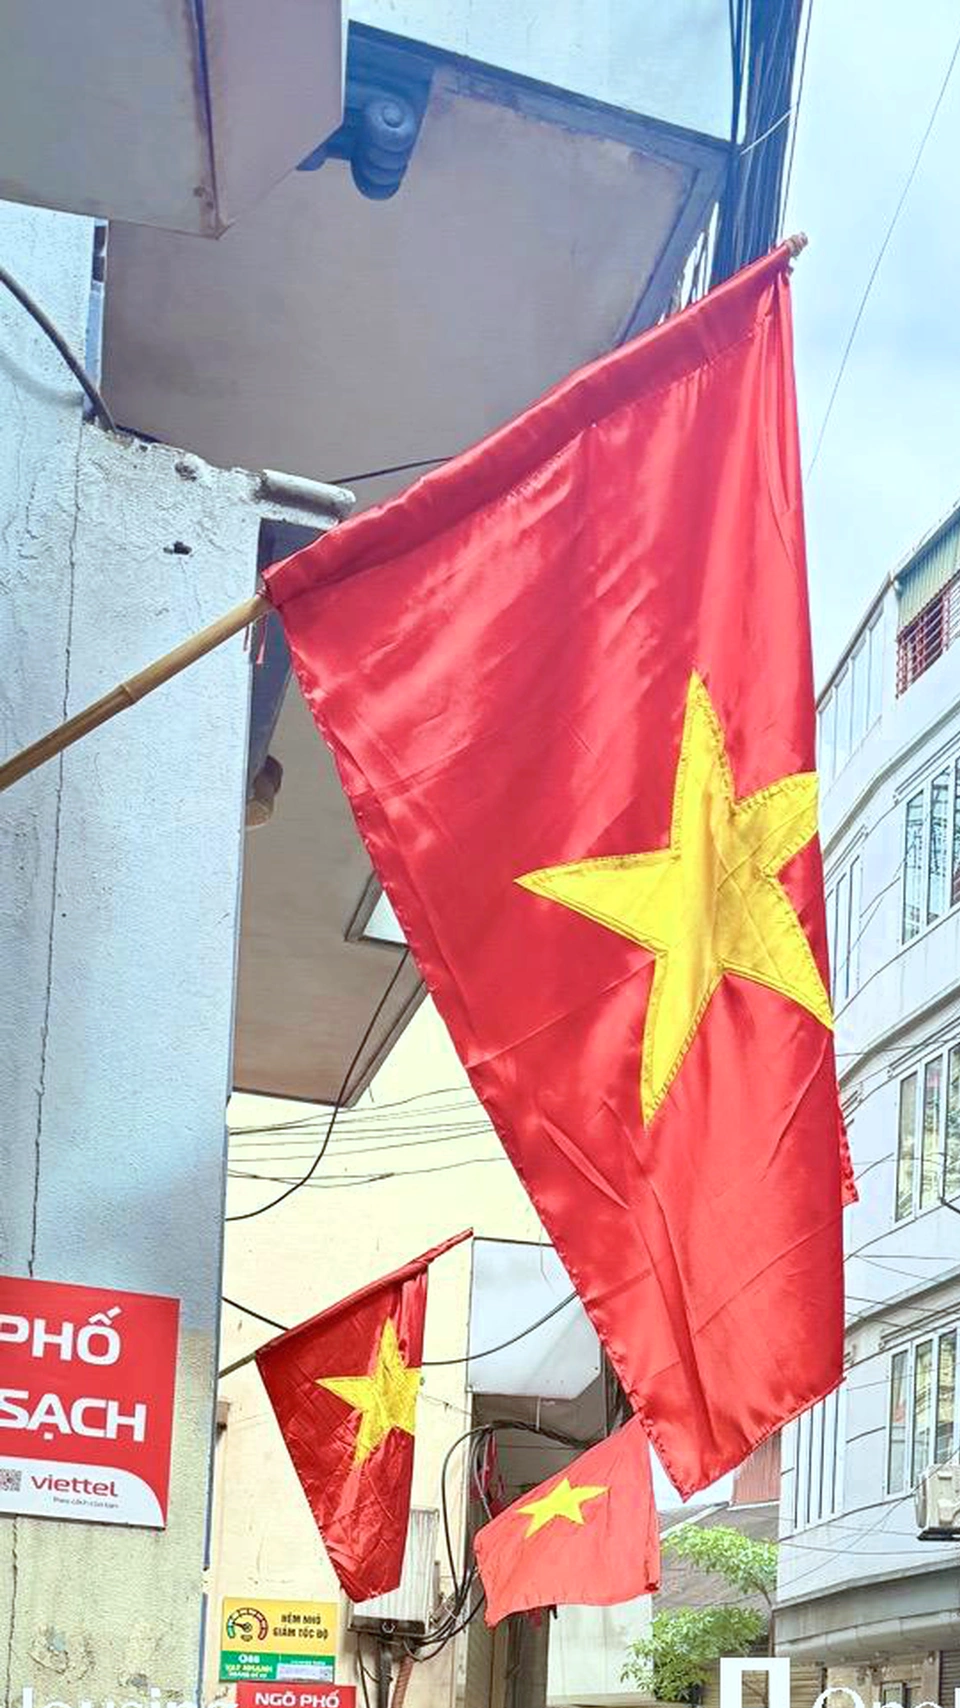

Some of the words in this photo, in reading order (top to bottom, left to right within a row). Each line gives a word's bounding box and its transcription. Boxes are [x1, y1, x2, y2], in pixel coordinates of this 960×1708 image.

[0, 1306, 122, 1366] PHỐ
[0, 1388, 147, 1442] SẠCH
[31, 1475, 118, 1497] viettel
[300, 1690, 340, 1708] PHỐ
